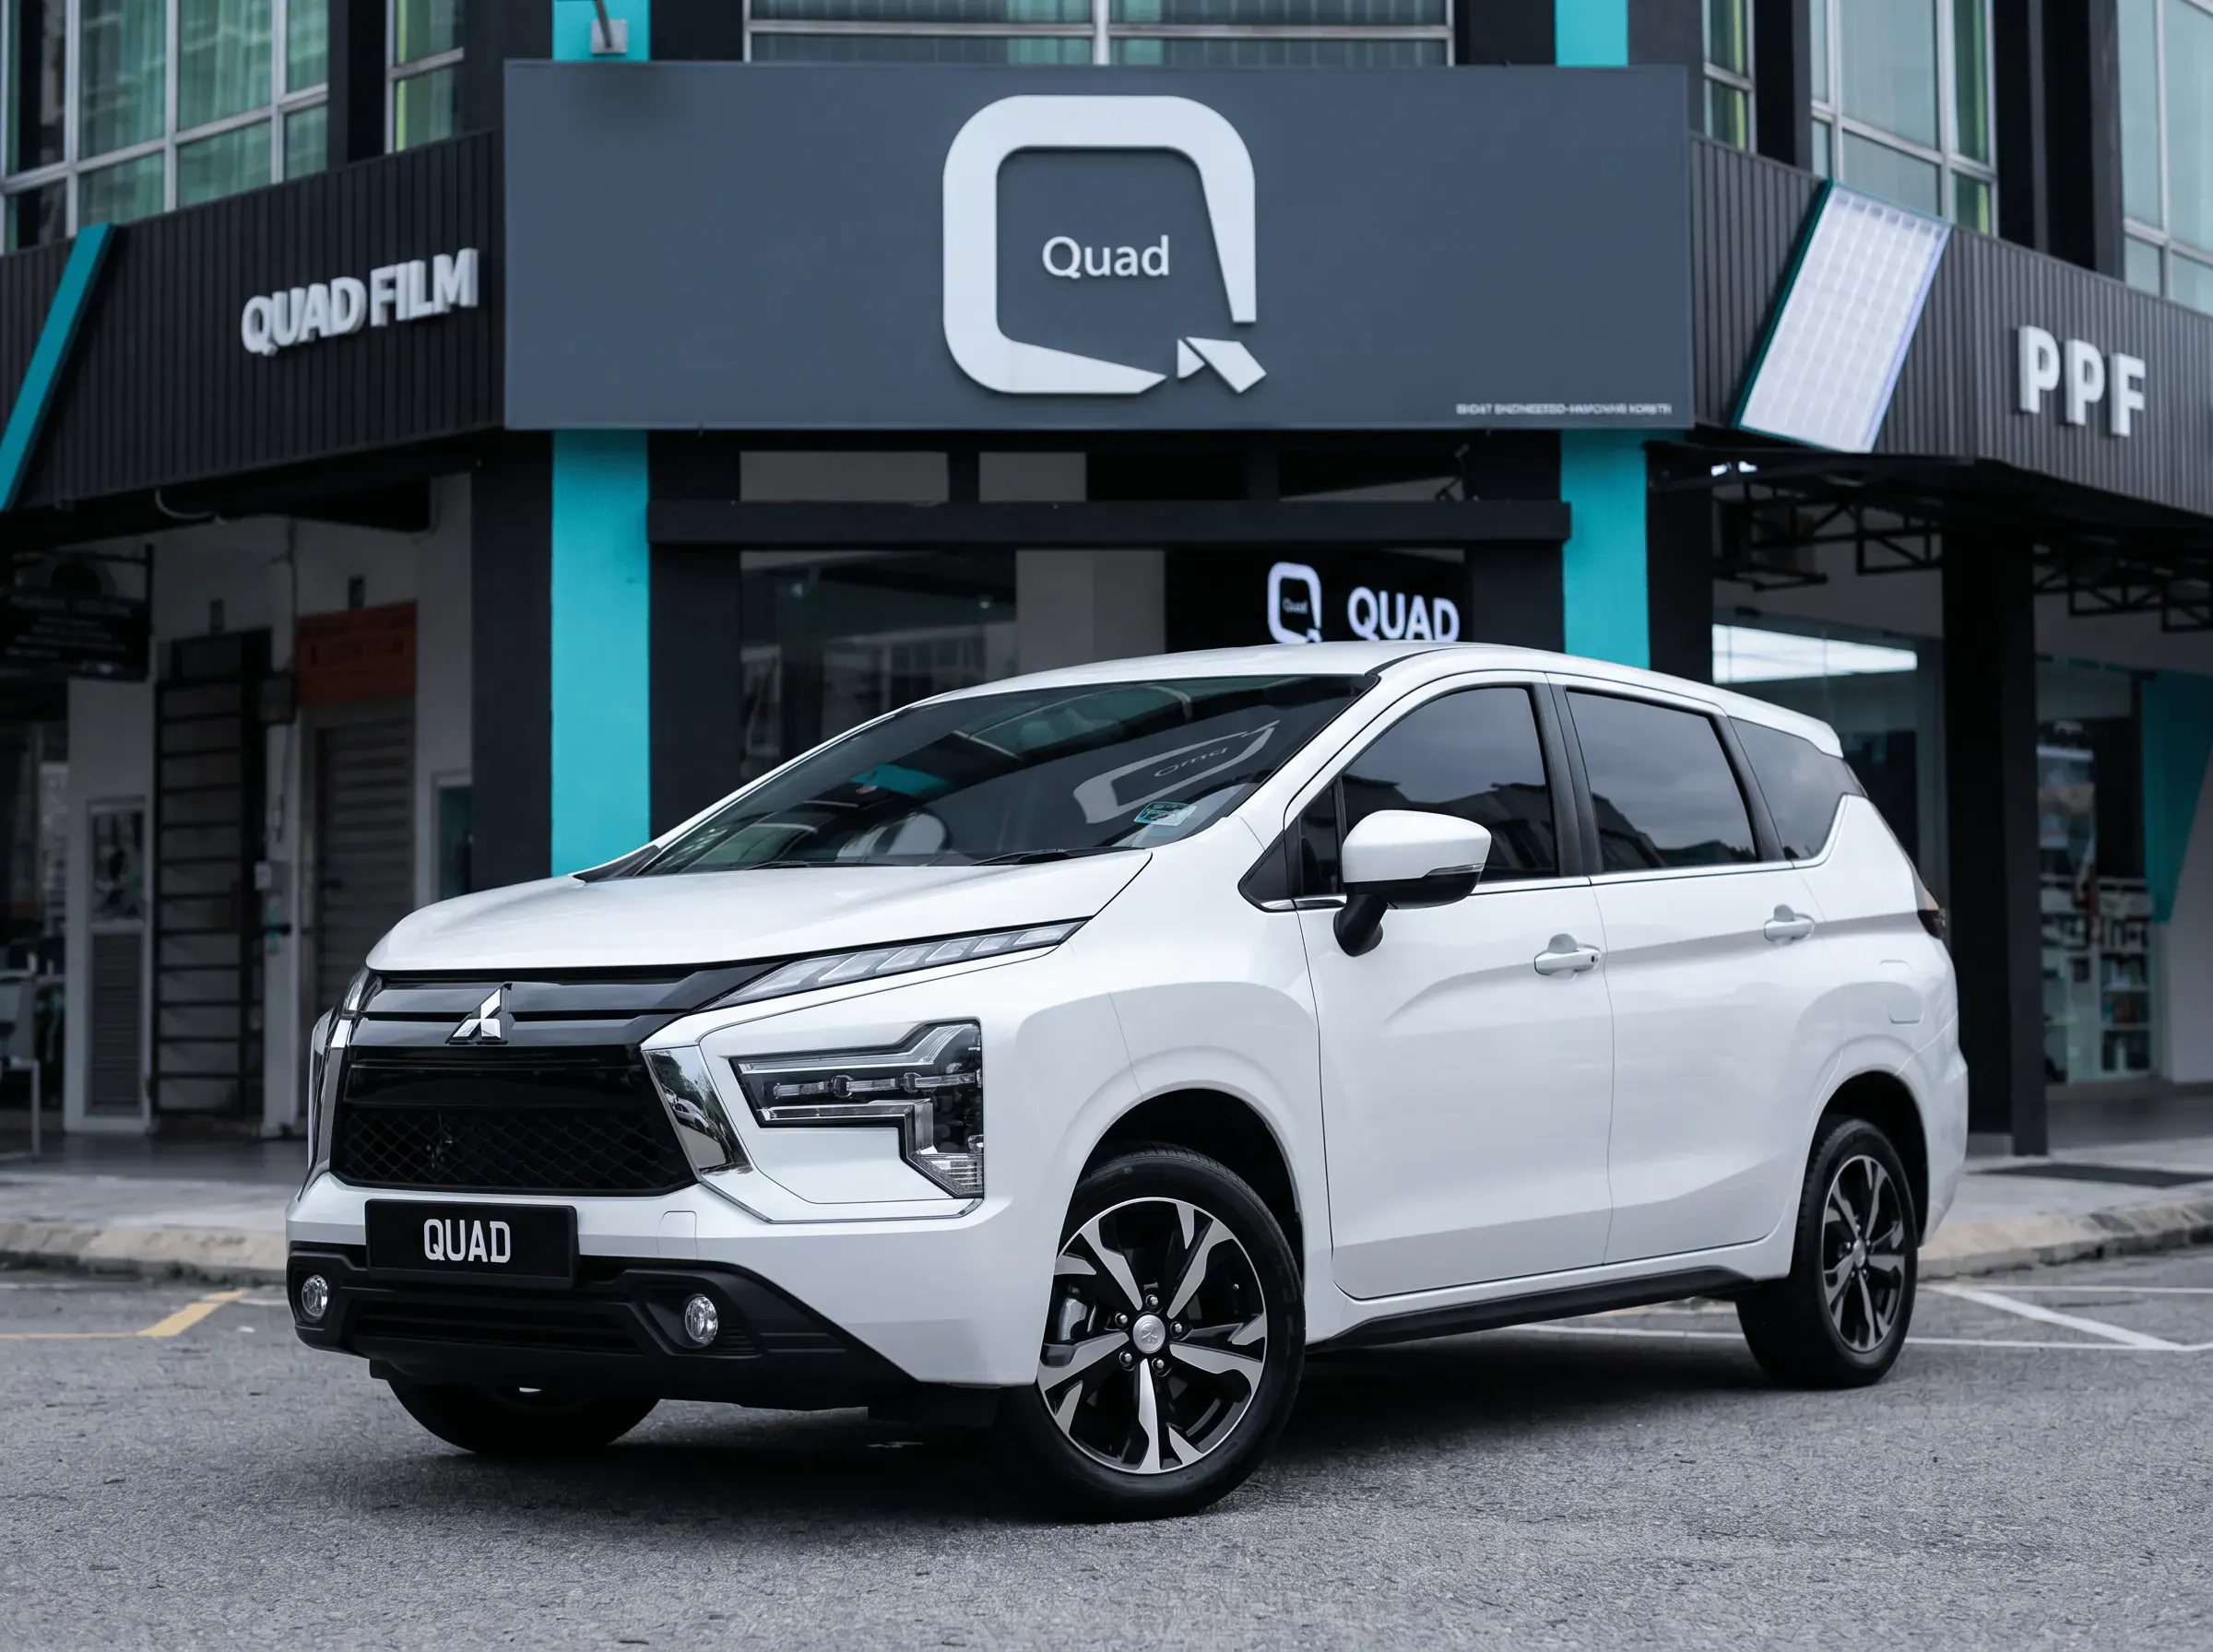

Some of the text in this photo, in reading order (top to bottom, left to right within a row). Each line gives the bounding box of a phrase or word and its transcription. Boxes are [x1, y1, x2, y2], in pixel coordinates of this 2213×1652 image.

[1042, 234, 1170, 279] Quad
[241, 247, 479, 356] QUAD FILM
[2018, 324, 2147, 438] PPF
[1347, 586, 1461, 642] QUAD
[423, 1218, 512, 1264] QUAD
